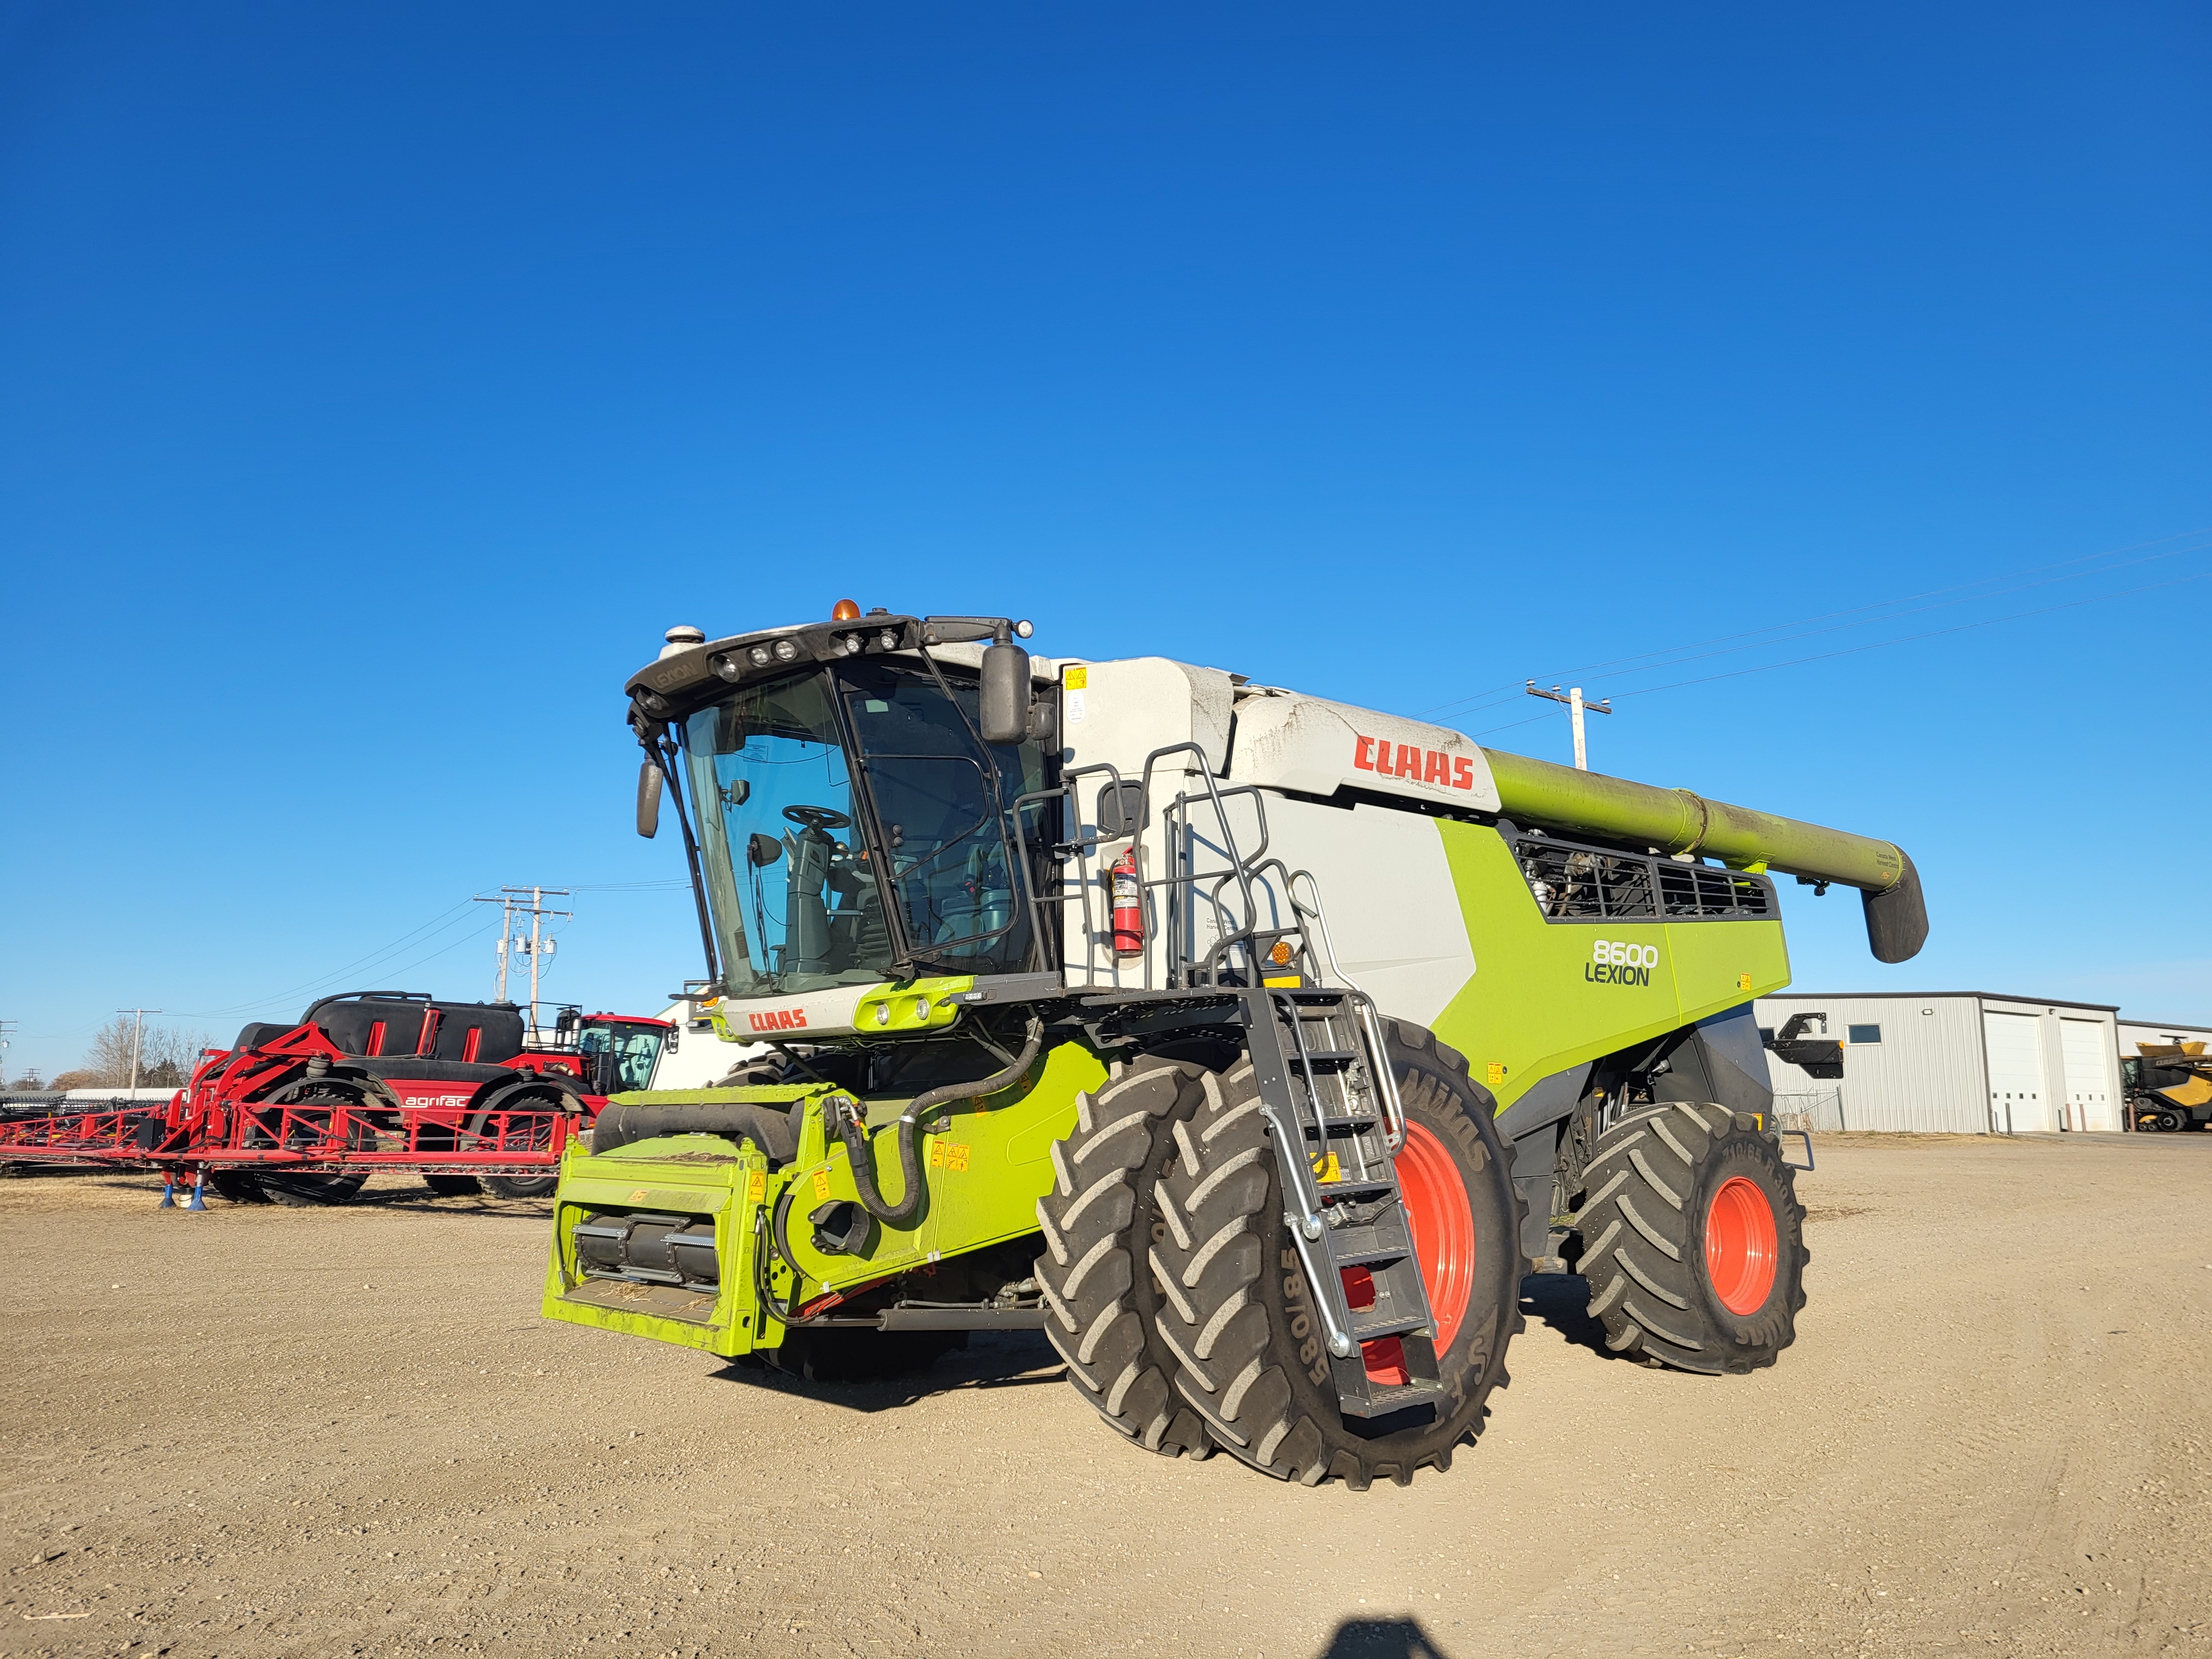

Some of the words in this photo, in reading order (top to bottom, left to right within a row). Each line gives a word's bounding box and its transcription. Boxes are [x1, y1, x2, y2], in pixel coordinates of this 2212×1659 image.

[652, 663, 699, 688] LEXION
[1354, 735, 1473, 790] CLAAS
[1593, 940, 1658, 968] 8600
[1585, 962, 1649, 987] LEXION
[749, 1009, 807, 1031] CLAAS
[401, 1095, 472, 1108] agrifac
[1398, 1067, 1492, 1172] Mitas
[1722, 1141, 1763, 1164] 710/65
[1765, 1156, 1776, 1176] R
[1774, 1172, 1788, 1200] 30
[1281, 1246, 1329, 1387] 580/85
